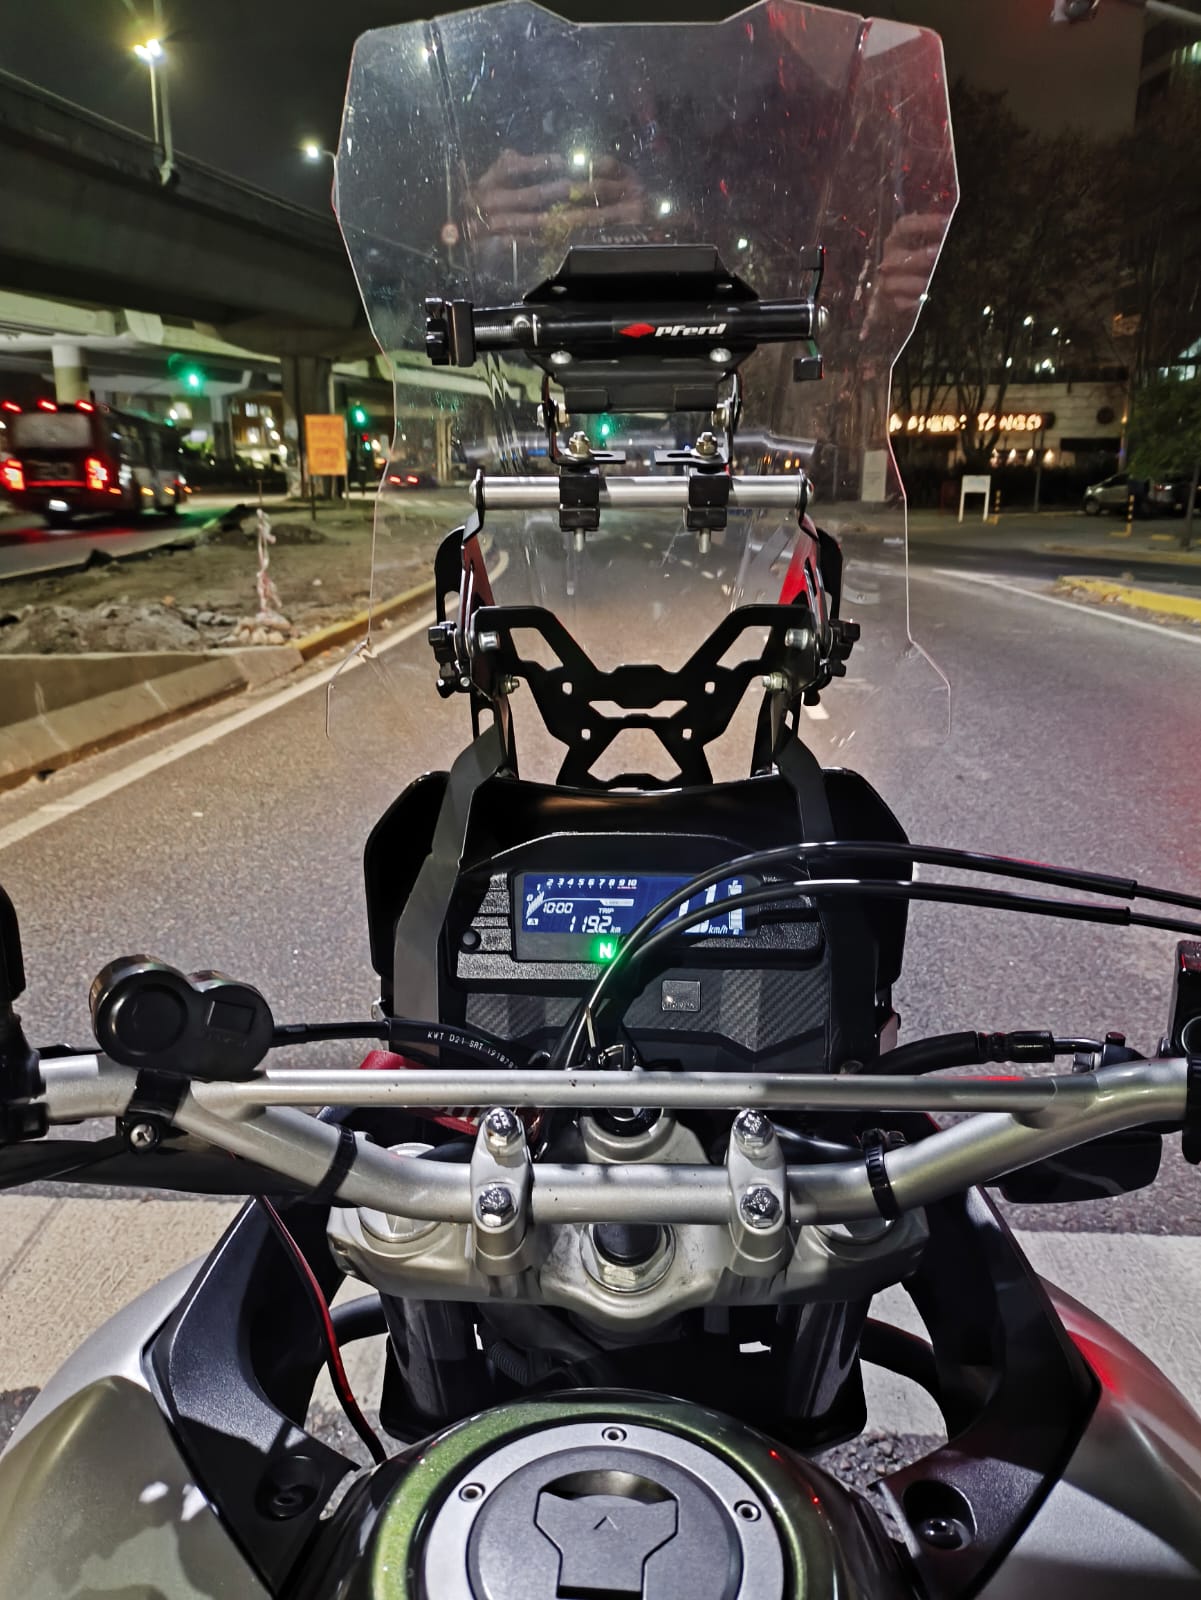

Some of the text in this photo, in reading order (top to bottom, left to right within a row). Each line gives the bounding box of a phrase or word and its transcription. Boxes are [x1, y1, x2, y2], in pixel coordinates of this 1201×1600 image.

[546, 878, 554, 886] 2
[557, 878, 565, 886] 3
[567, 878, 574, 886] 4
[577, 878, 585, 886] 5
[587, 878, 595, 886] 6
[599, 878, 606, 886] 7
[618, 878, 626, 886] 9
[627, 878, 638, 886] 10
[708, 924, 728, 934] km/h
[599, 942, 612, 959] N
